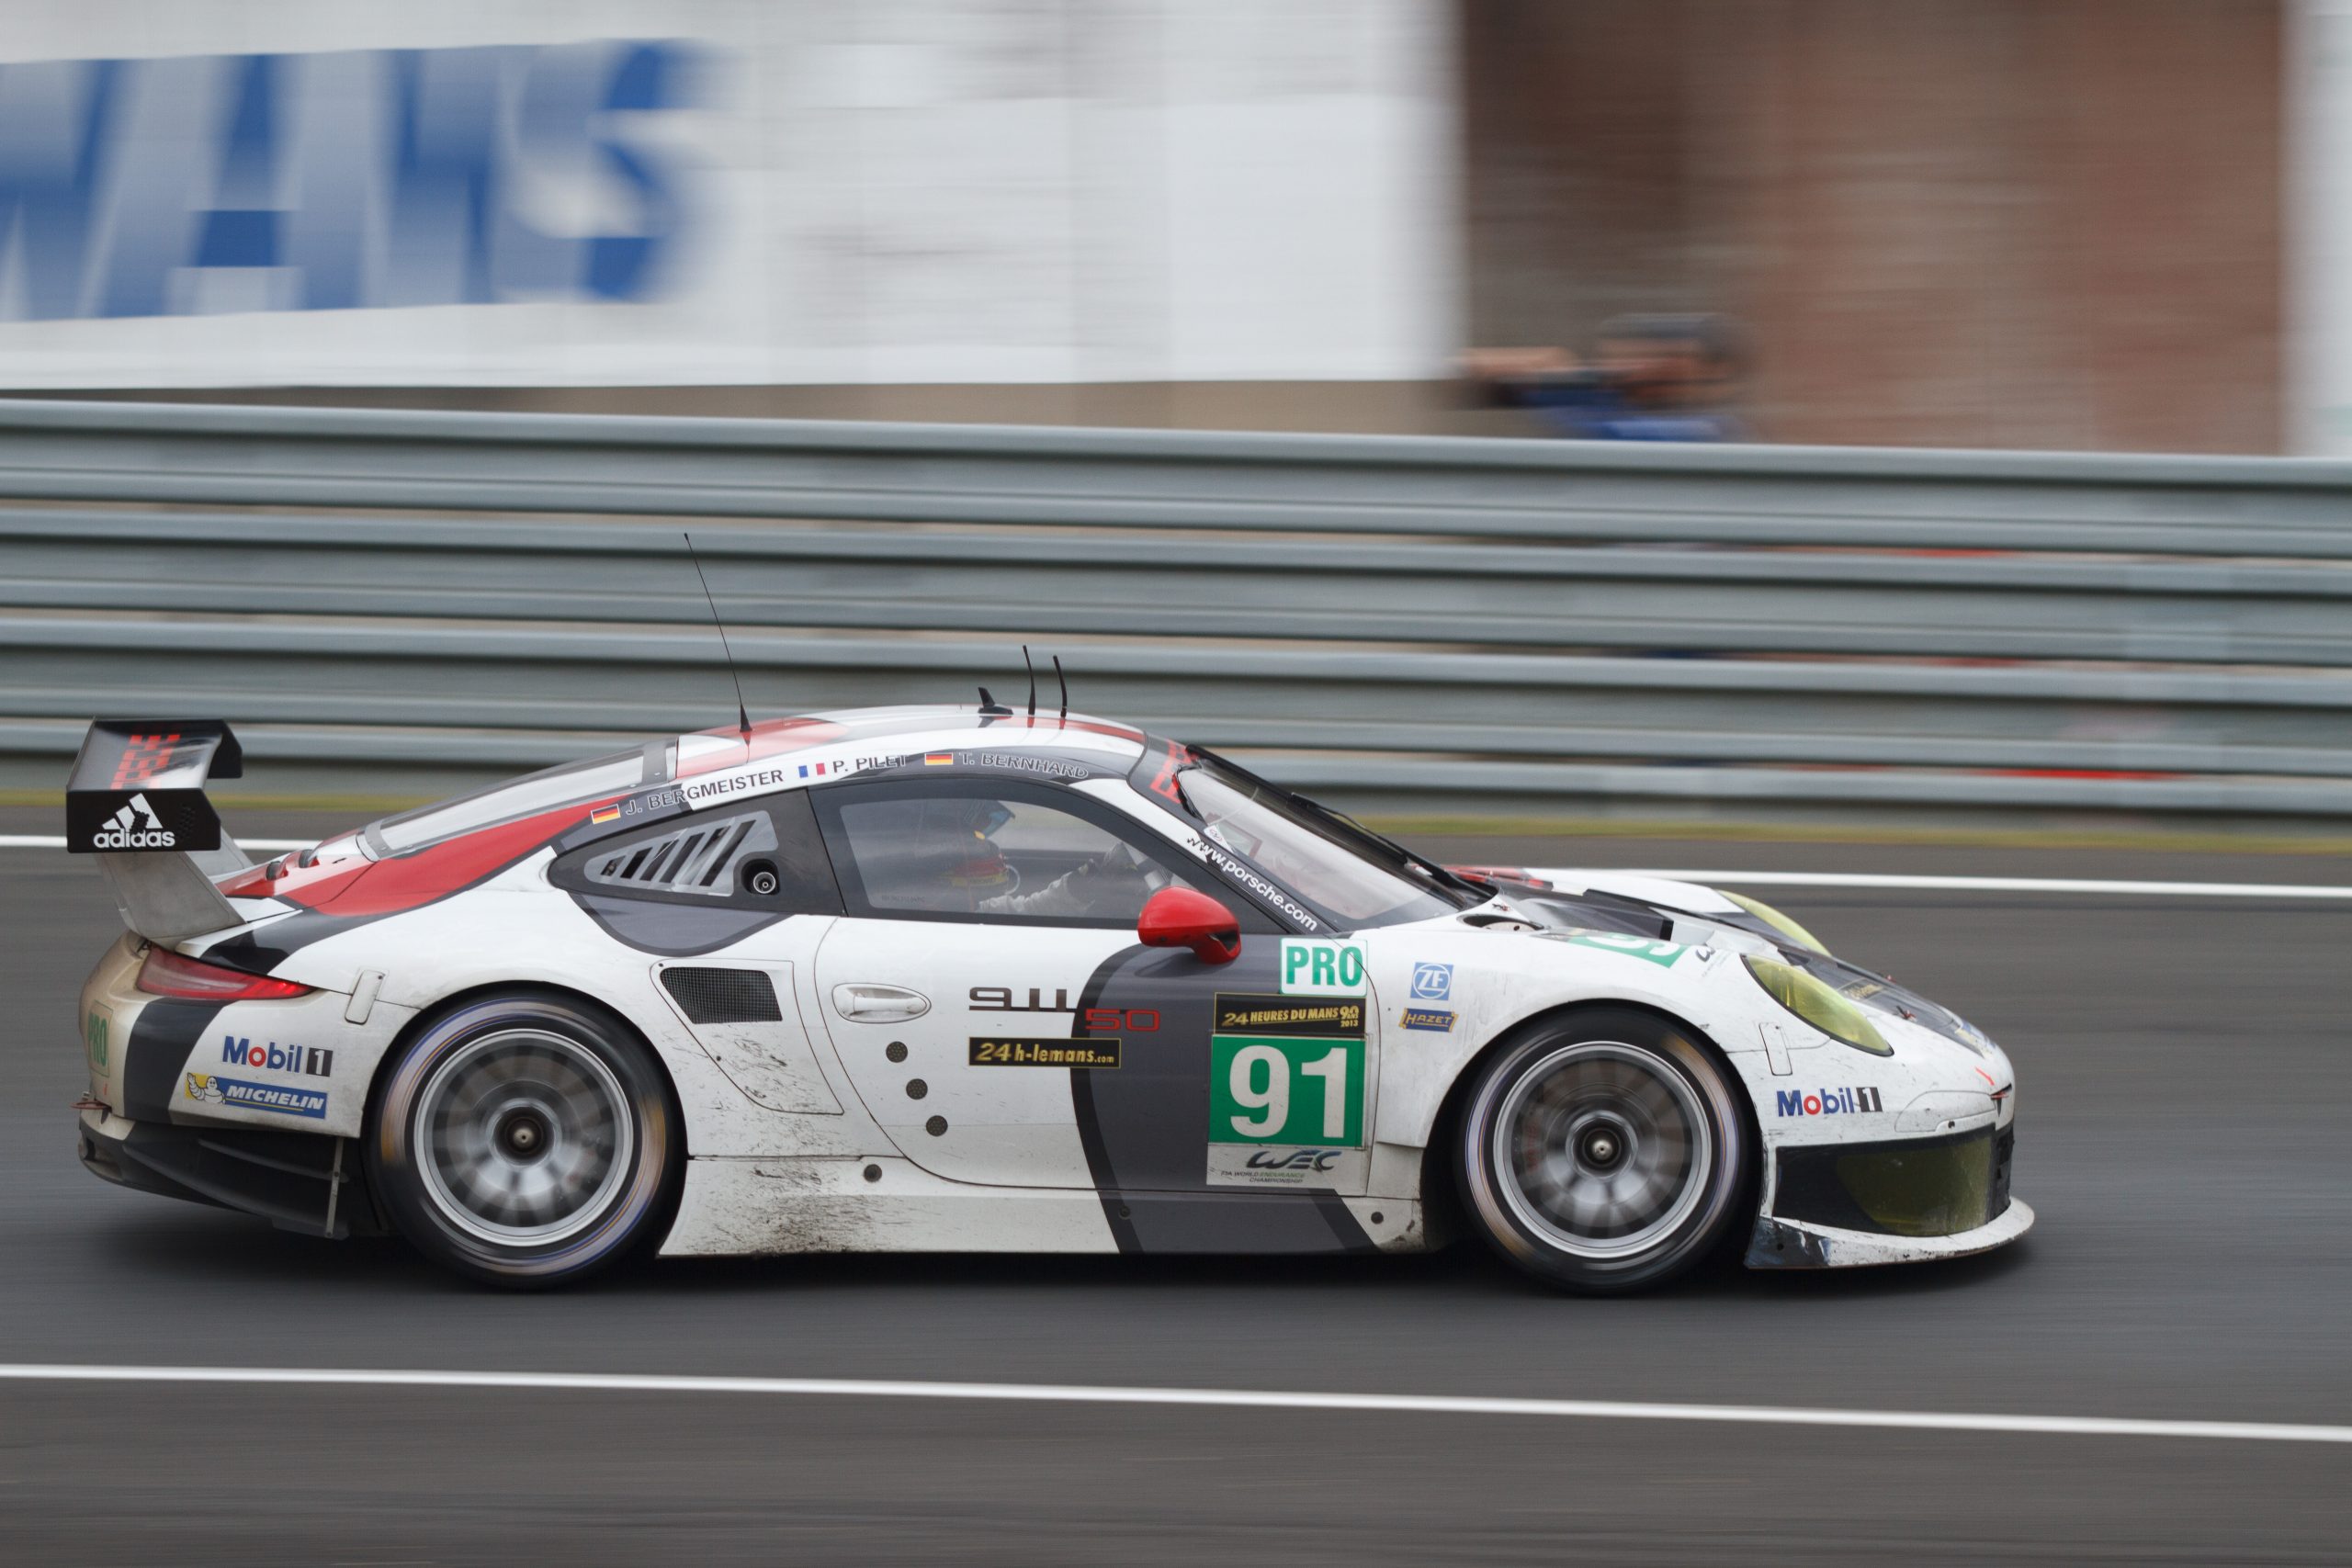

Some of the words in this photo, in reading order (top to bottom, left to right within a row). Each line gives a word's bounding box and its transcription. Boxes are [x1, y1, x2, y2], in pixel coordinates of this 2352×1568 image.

[832, 760, 849, 774] P.
[855, 754, 909, 771] PILET
[980, 753, 1090, 779] BERNHARD
[625, 800, 643, 816] J.
[648, 769, 785, 810] BERGMEISTER
[93, 828, 175, 849] adidas
[1186, 837, 1318, 931] www.porsche.com
[1286, 946, 1363, 987] PRO
[1417, 968, 1448, 992] ZF
[969, 987, 1068, 1011] 911
[1085, 1009, 1160, 1032] 50
[1222, 1011, 1249, 1027] 24
[1250, 1009, 1288, 1023] HEURES
[1290, 1008, 1306, 1021] DU
[1307, 1007, 1340, 1019] MANS
[1406, 1013, 1453, 1025] HAZET
[1340, 1020, 1359, 1028] 2013
[87, 1012, 107, 1067] PRO
[222, 1035, 303, 1074] Mobil
[976, 1043, 1115, 1064] 24h-lemans.com
[226, 1085, 325, 1111] MICHELIN
[1229, 1044, 1348, 1139] 91
[1776, 1087, 1855, 1118] Mobil
[1246, 1149, 1343, 1173] WEC
